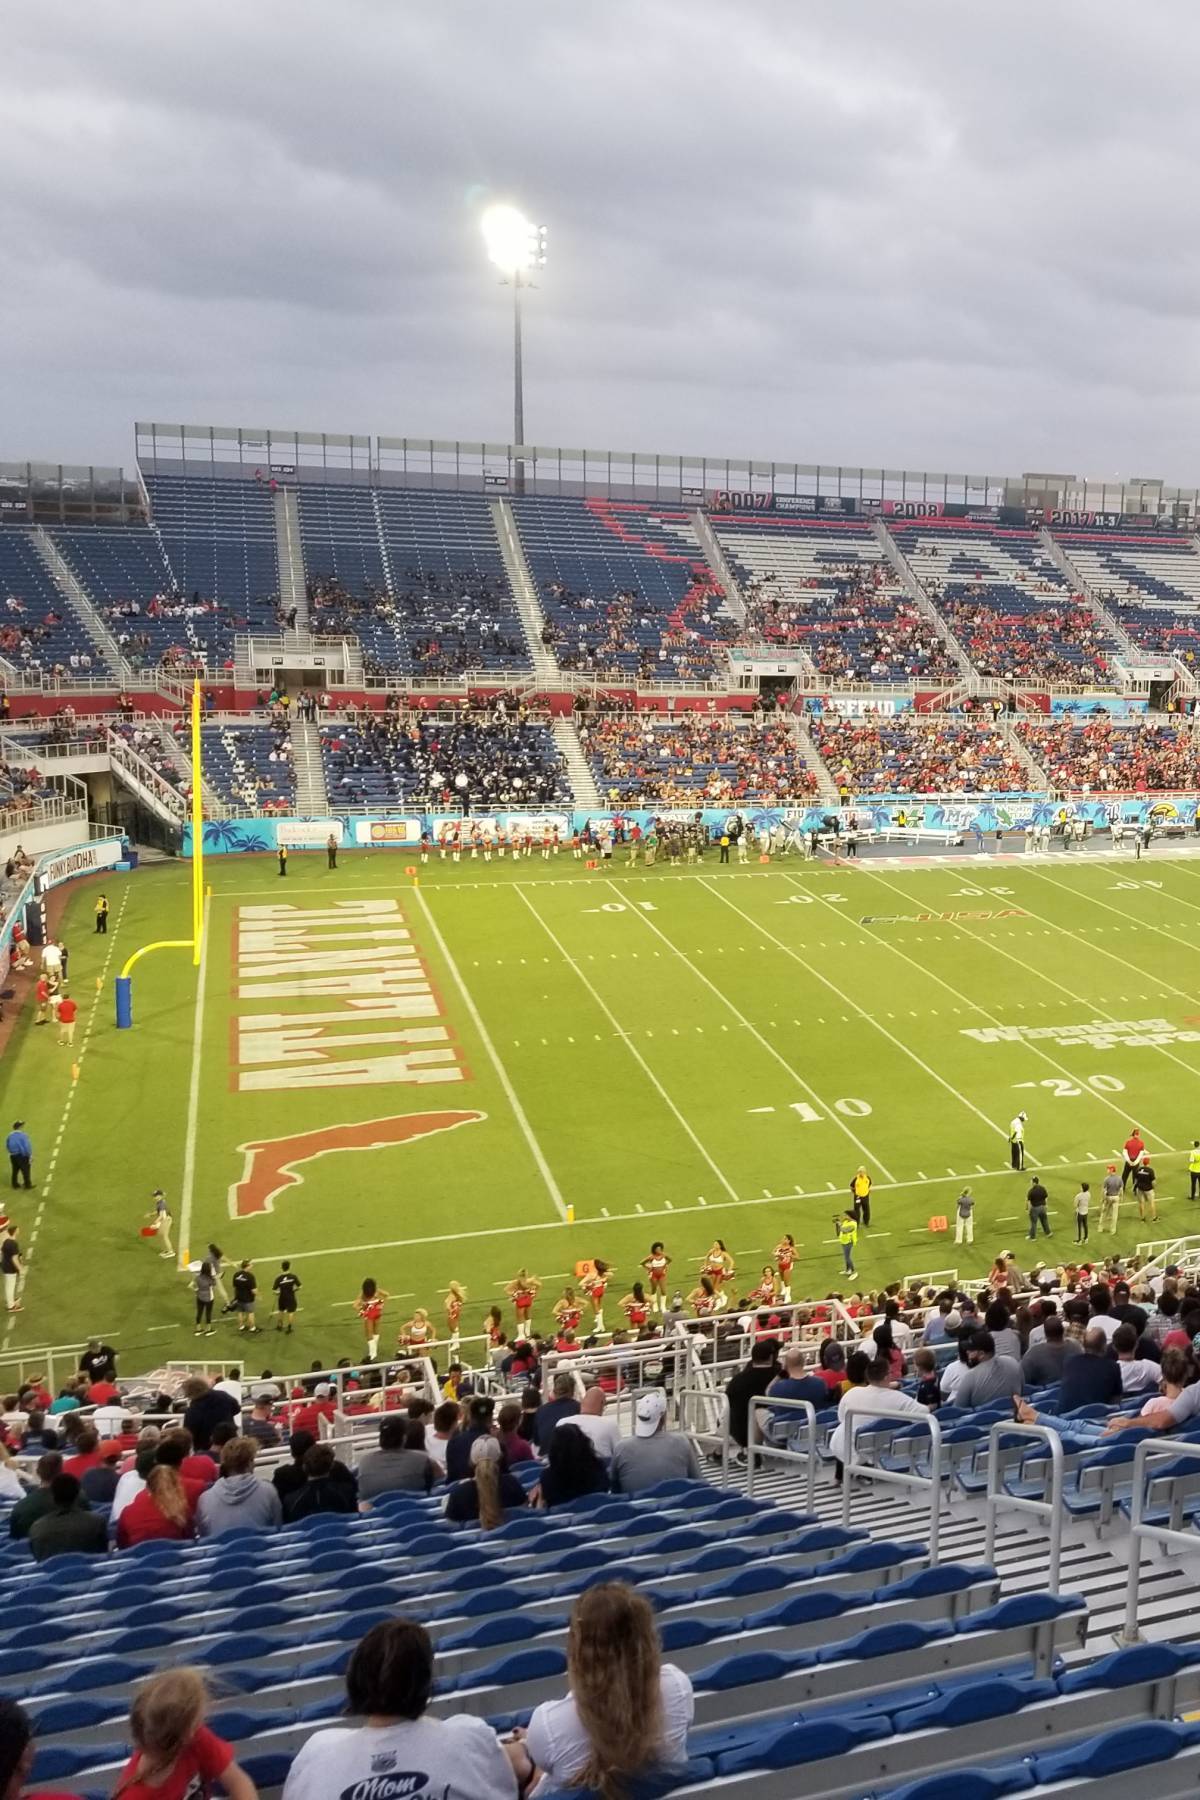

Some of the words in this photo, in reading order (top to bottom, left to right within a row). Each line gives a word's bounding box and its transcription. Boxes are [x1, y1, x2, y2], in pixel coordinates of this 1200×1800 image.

[717, 491, 769, 510] 2007
[893, 502, 938, 518] 2008
[1051, 509, 1089, 526] 2017
[1093, 515, 1116, 527] 11-3
[66, 849, 94, 873] BUDDHA
[236, 899, 468, 1092] ATLANTIC
[1038, 1074, 1127, 1097] 20
[788, 1098, 873, 1122] 10
[351, 1776, 417, 1800] Mom
